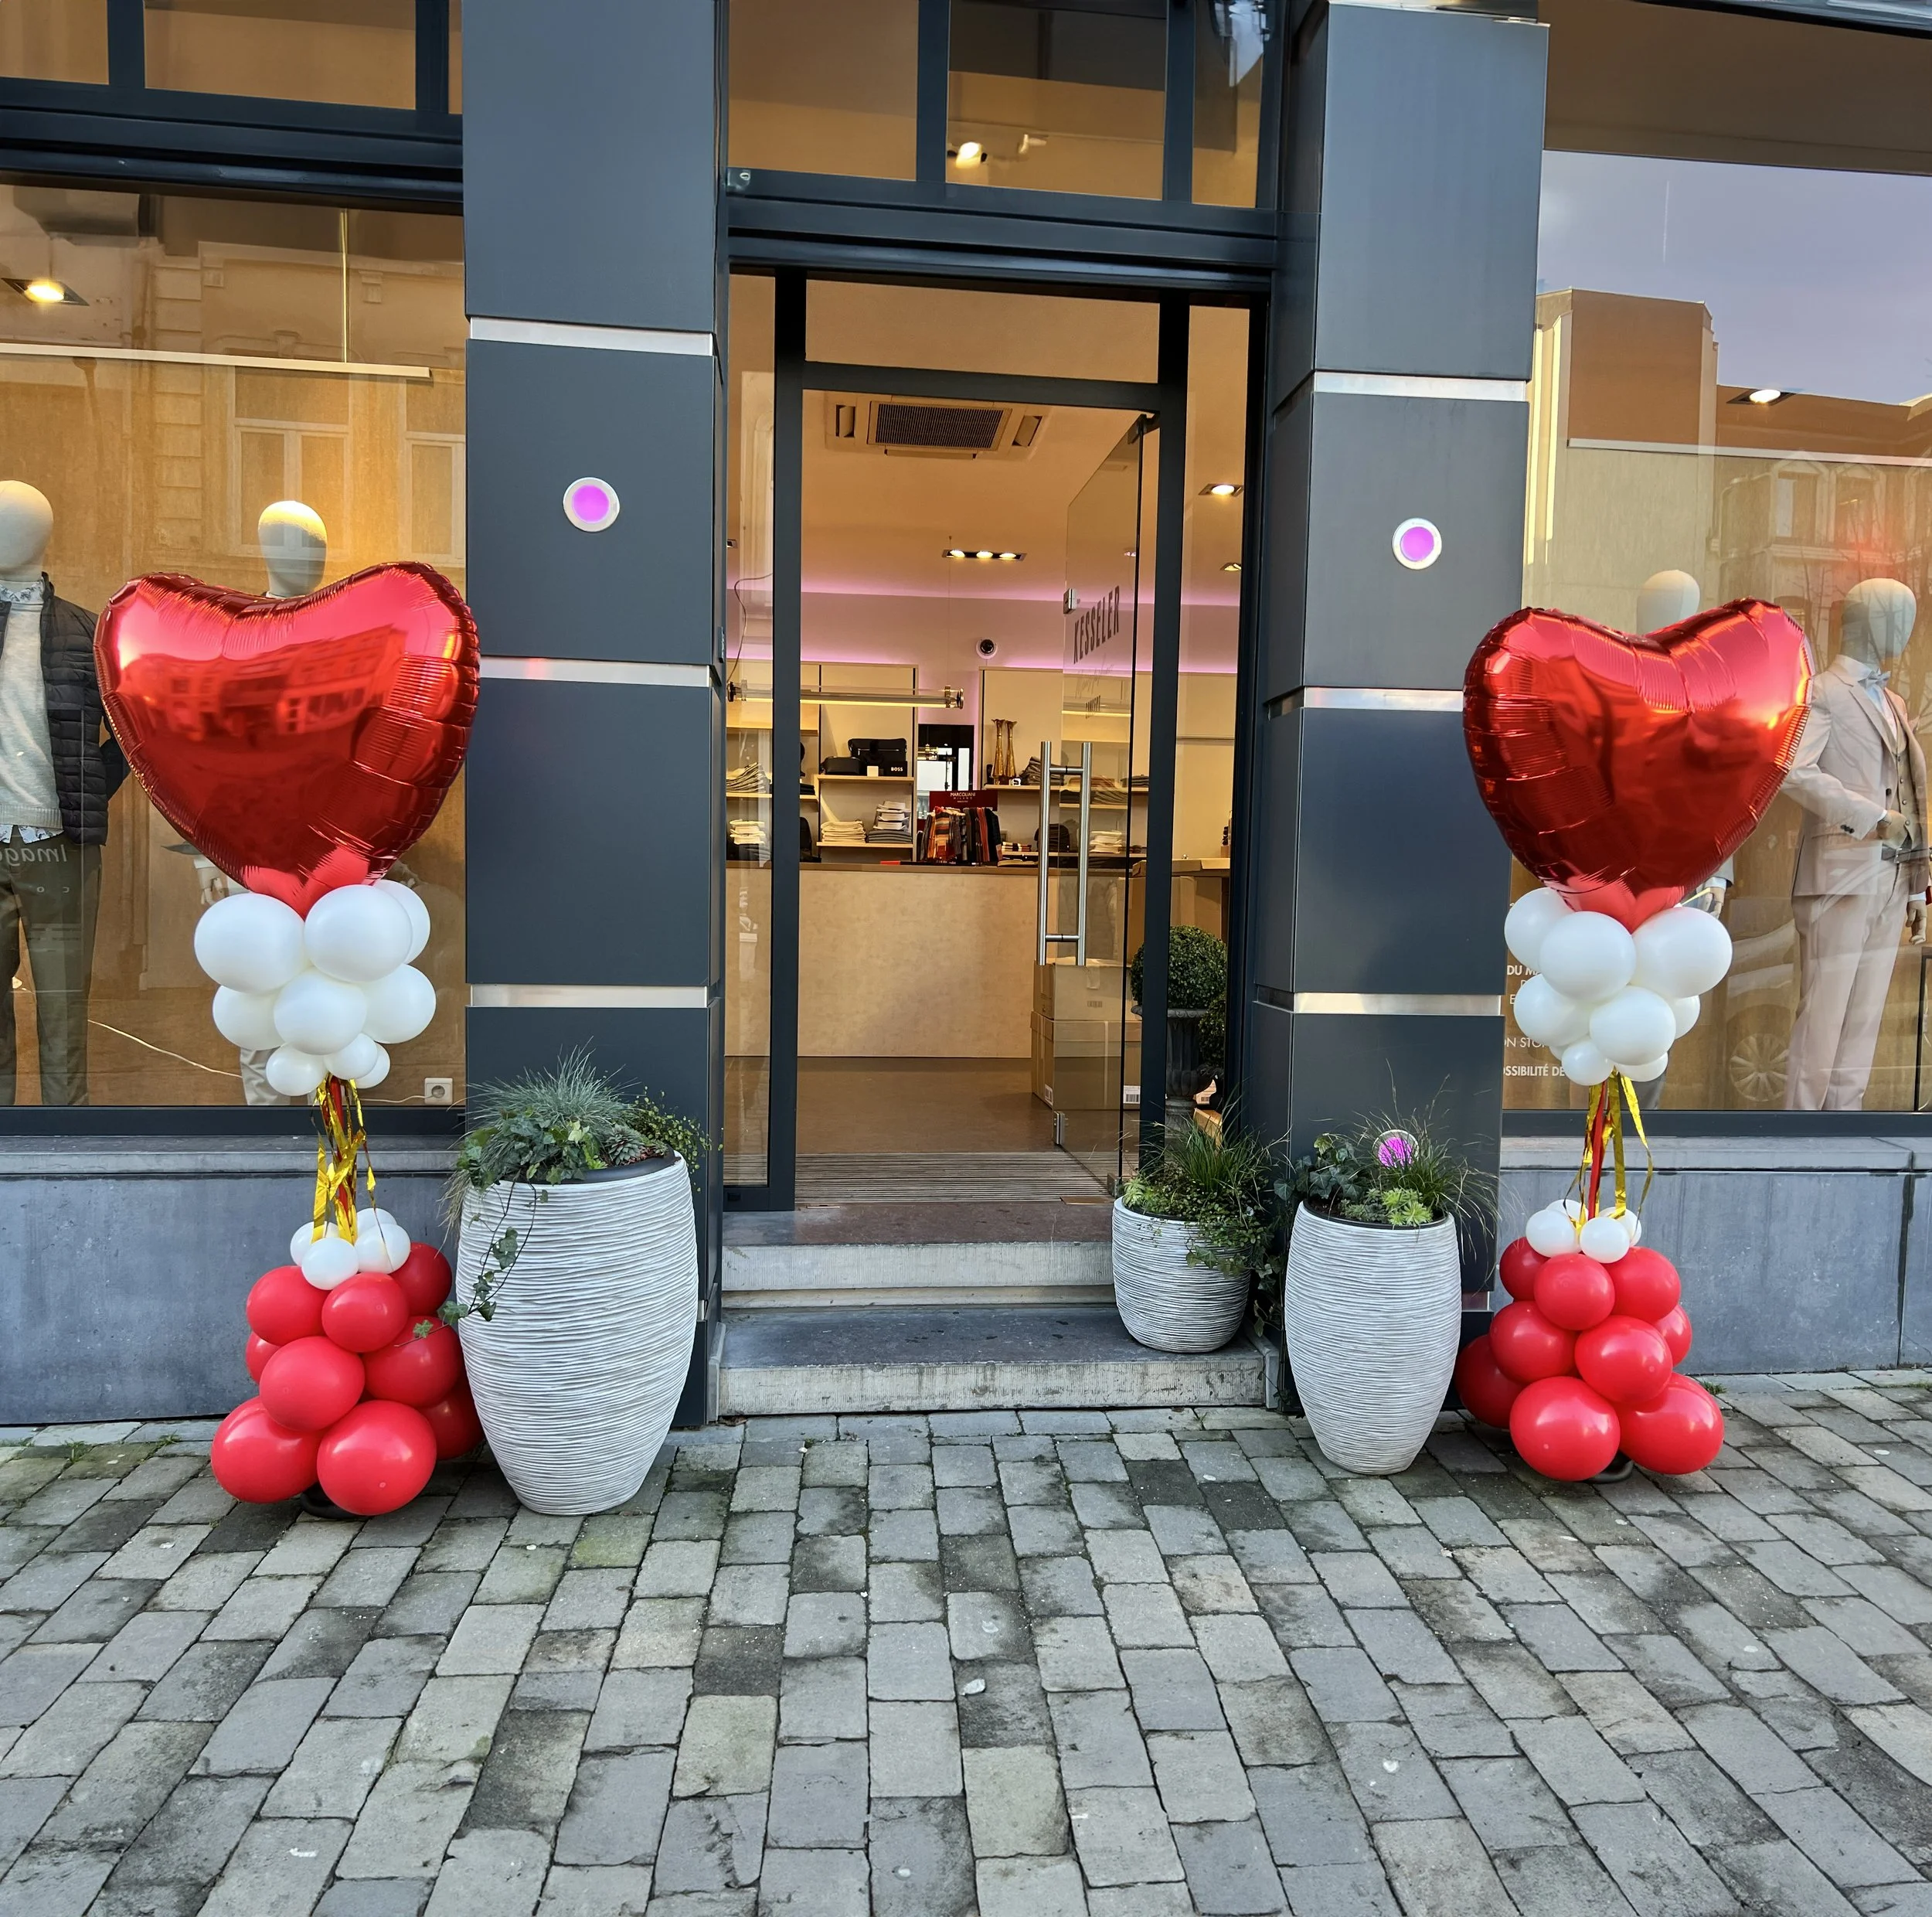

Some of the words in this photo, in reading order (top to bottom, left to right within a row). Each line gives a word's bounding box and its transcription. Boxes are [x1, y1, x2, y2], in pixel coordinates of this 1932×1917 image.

[1073, 585, 1120, 665] KESSELER
[1507, 965, 1522, 976] DU
[1503, 1064, 1549, 1077] SSIBILITÉ
